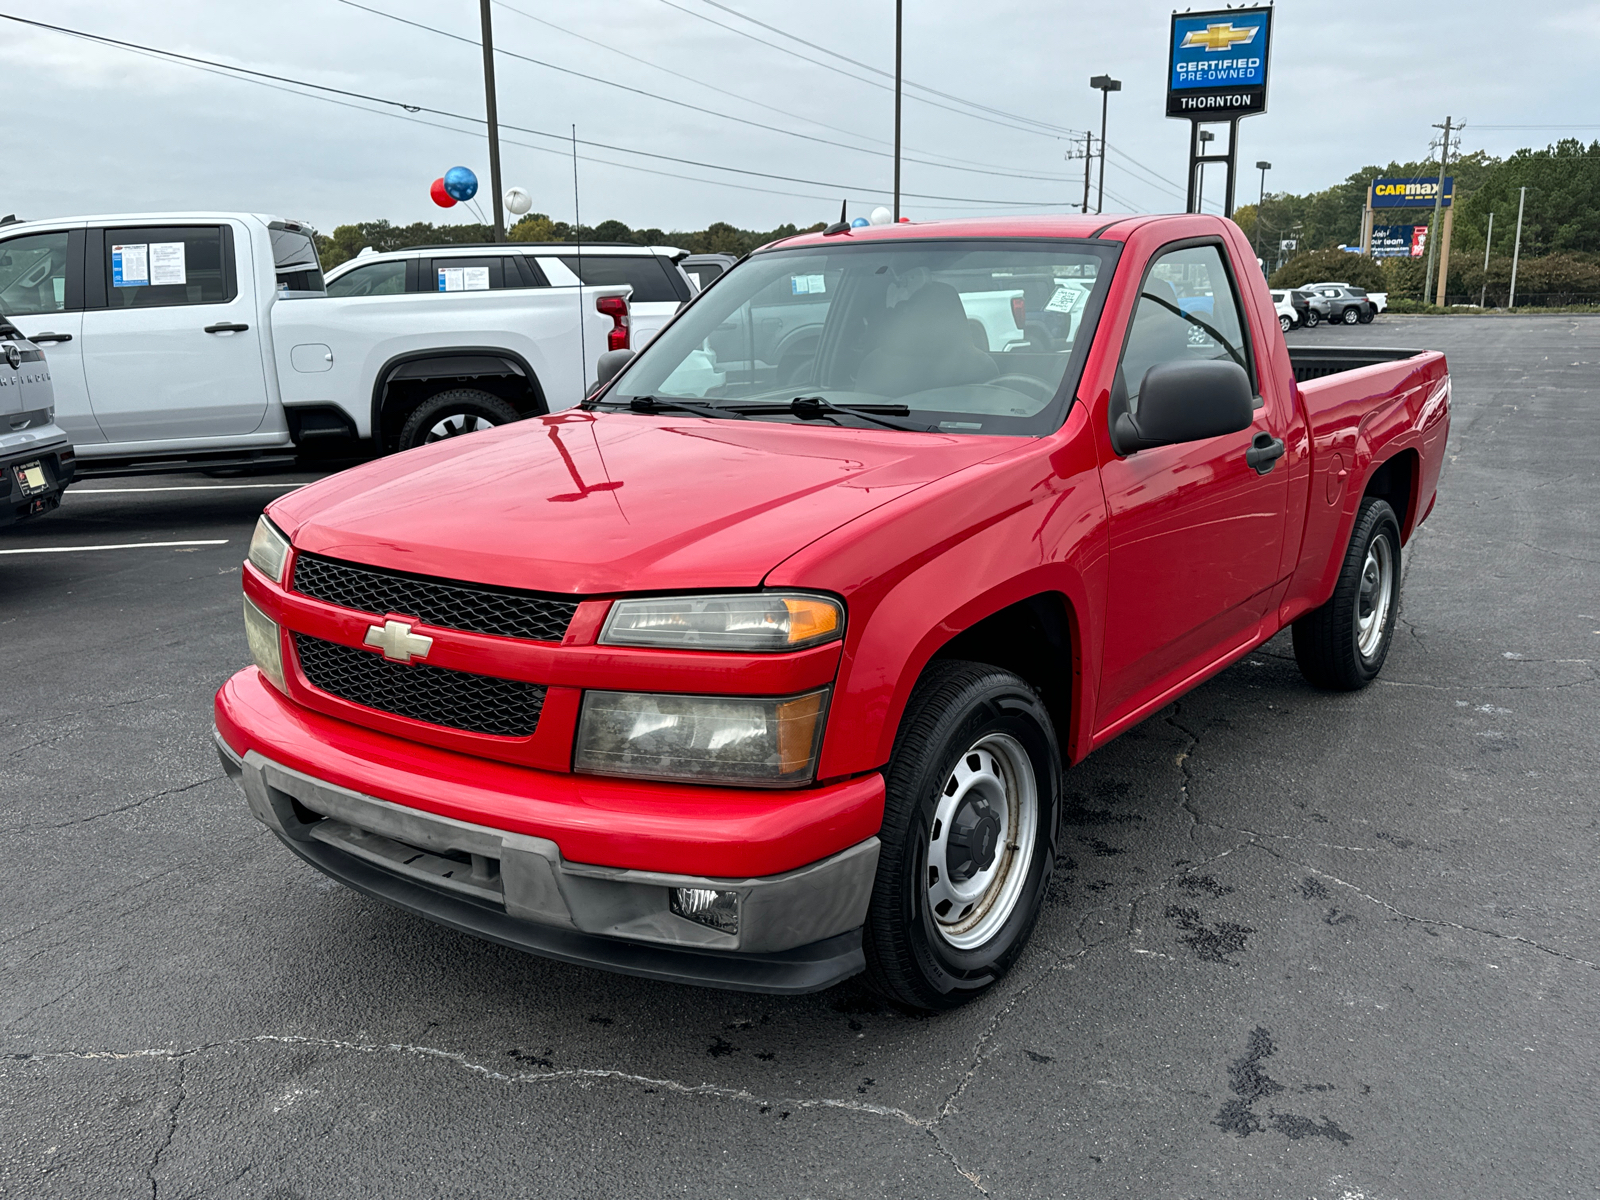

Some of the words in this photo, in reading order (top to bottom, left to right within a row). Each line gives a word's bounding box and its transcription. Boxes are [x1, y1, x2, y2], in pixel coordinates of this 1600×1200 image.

[1176, 58, 1260, 72] CERTIFIED
[1179, 68, 1255, 81] PRE-OWNED
[1180, 94, 1251, 109] THORNTON
